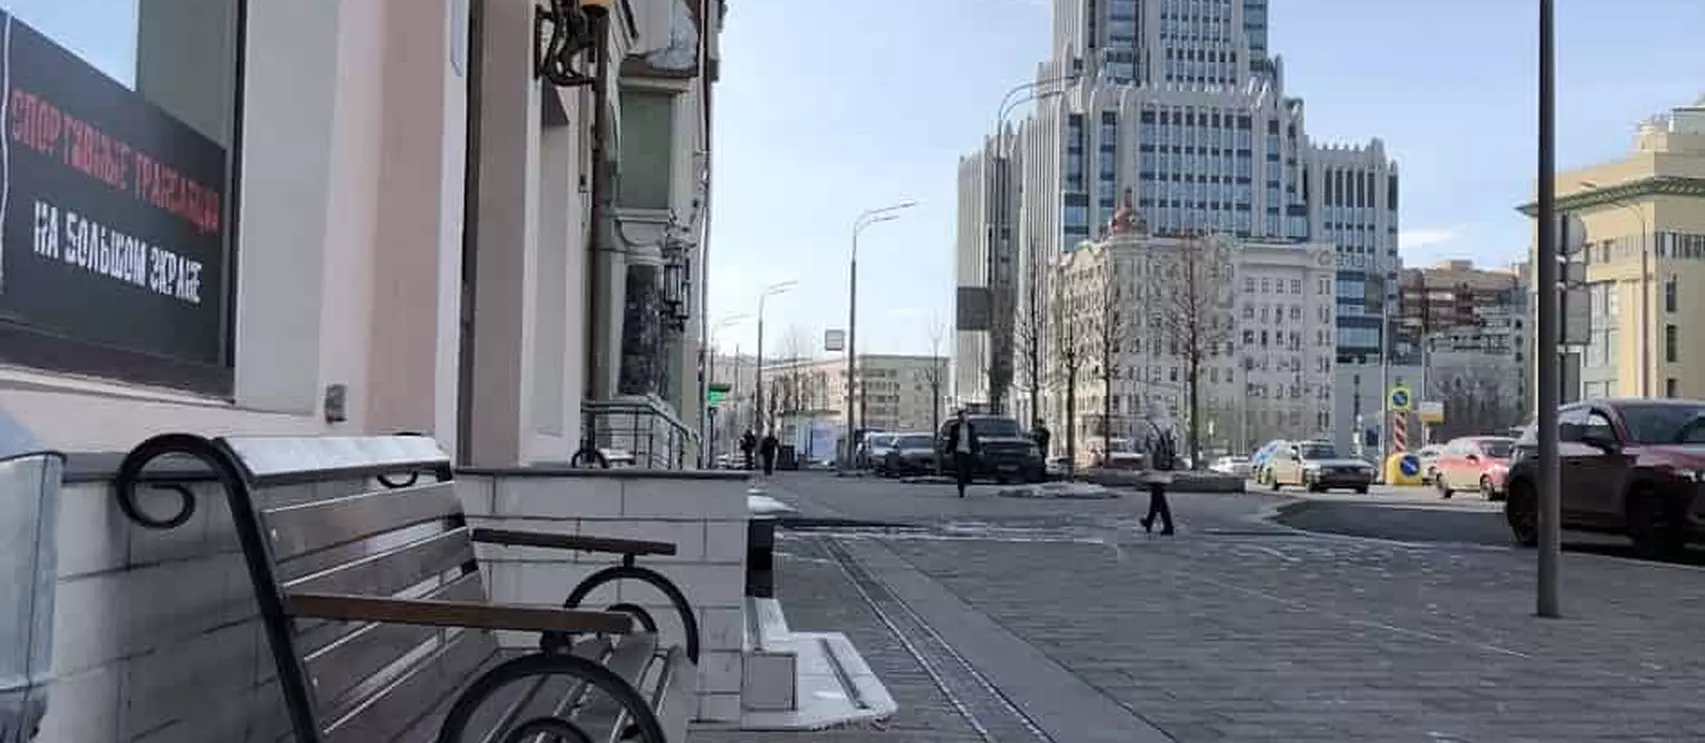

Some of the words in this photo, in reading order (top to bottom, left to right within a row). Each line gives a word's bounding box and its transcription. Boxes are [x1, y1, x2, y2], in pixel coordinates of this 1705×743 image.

[34, 200, 59, 260] НА
[65, 211, 146, 287] БОЛЬШОМ
[150, 246, 203, 303] ЭКРАНЕ
